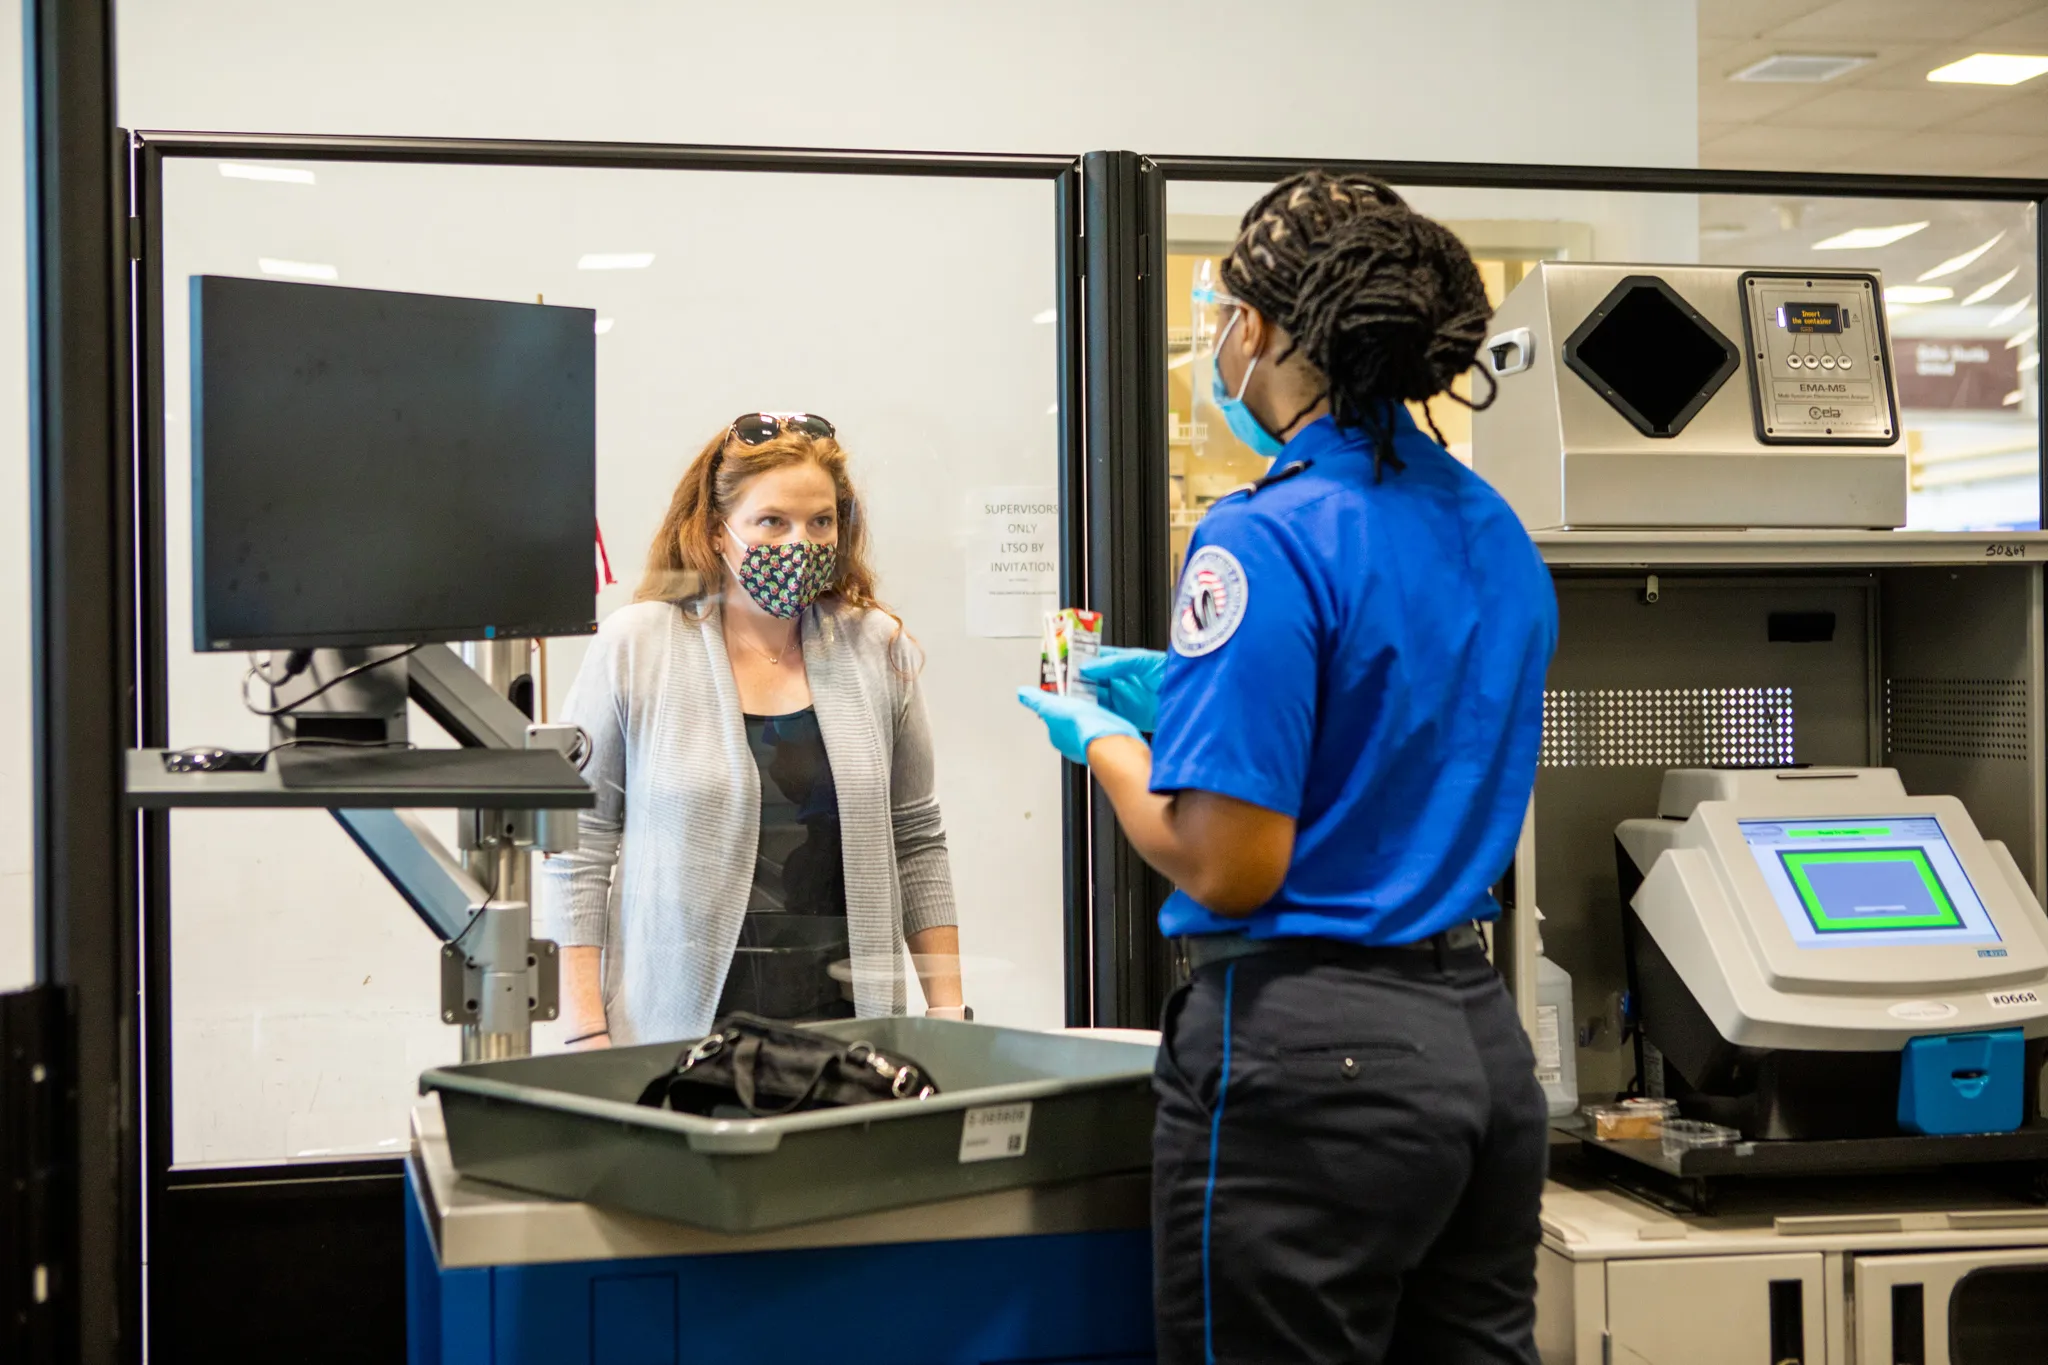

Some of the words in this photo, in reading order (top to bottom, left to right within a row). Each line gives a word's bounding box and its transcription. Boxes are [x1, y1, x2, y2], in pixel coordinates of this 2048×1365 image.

[1800, 384, 1846, 392] EMA-MS
[985, 504, 1058, 515] SUPERVISORS
[1007, 523, 1038, 534] ONLY
[1001, 543, 1028, 553] LTSO
[1031, 543, 1044, 553] BY
[991, 562, 1054, 572] INVITATION
[1993, 992, 2037, 1005] #0668
